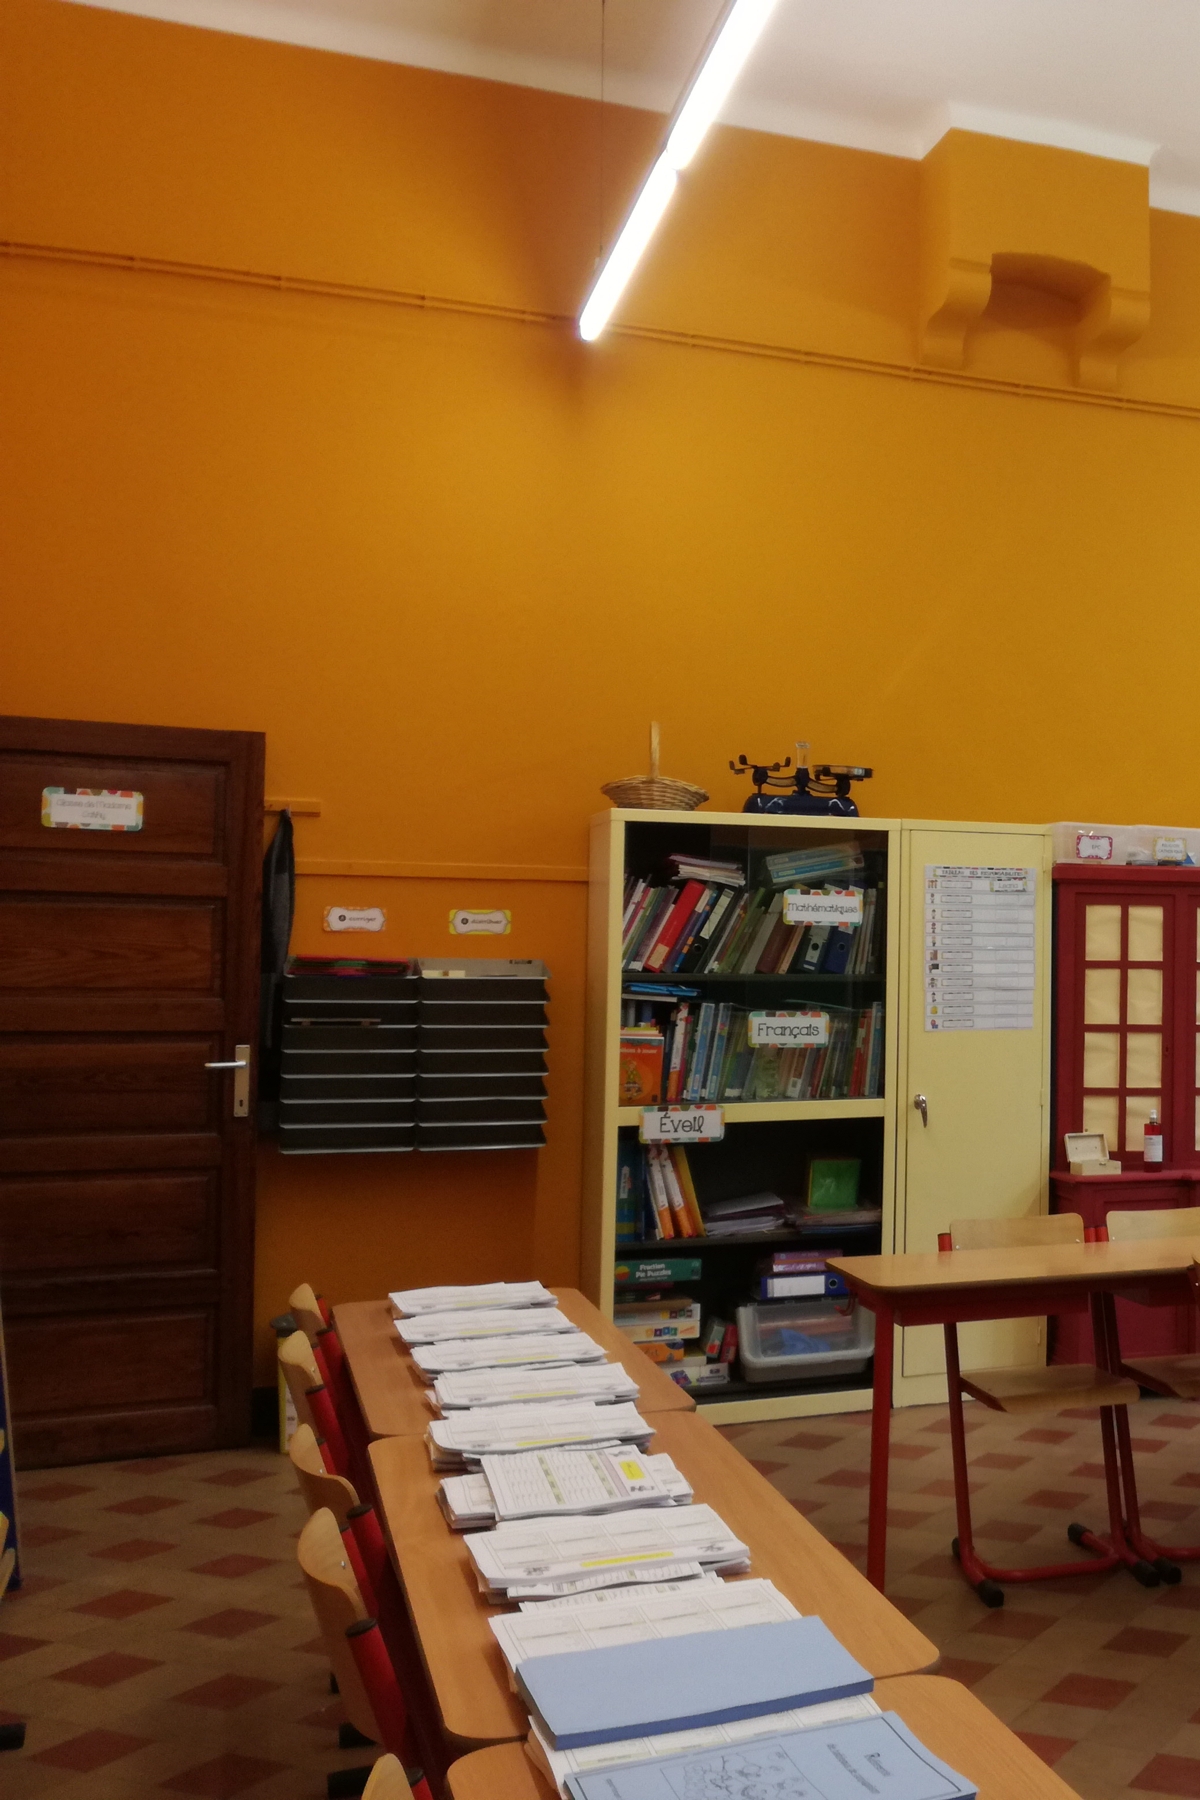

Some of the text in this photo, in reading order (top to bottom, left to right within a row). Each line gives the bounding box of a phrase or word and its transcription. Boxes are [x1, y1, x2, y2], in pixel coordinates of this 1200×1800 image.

[787, 902, 859, 916] Mathématiques
[757, 1022, 820, 1039] Français
[660, 1111, 705, 1134] Éveil
[639, 1263, 666, 1271] Fraction
[647, 1269, 672, 1277] Puzzles
